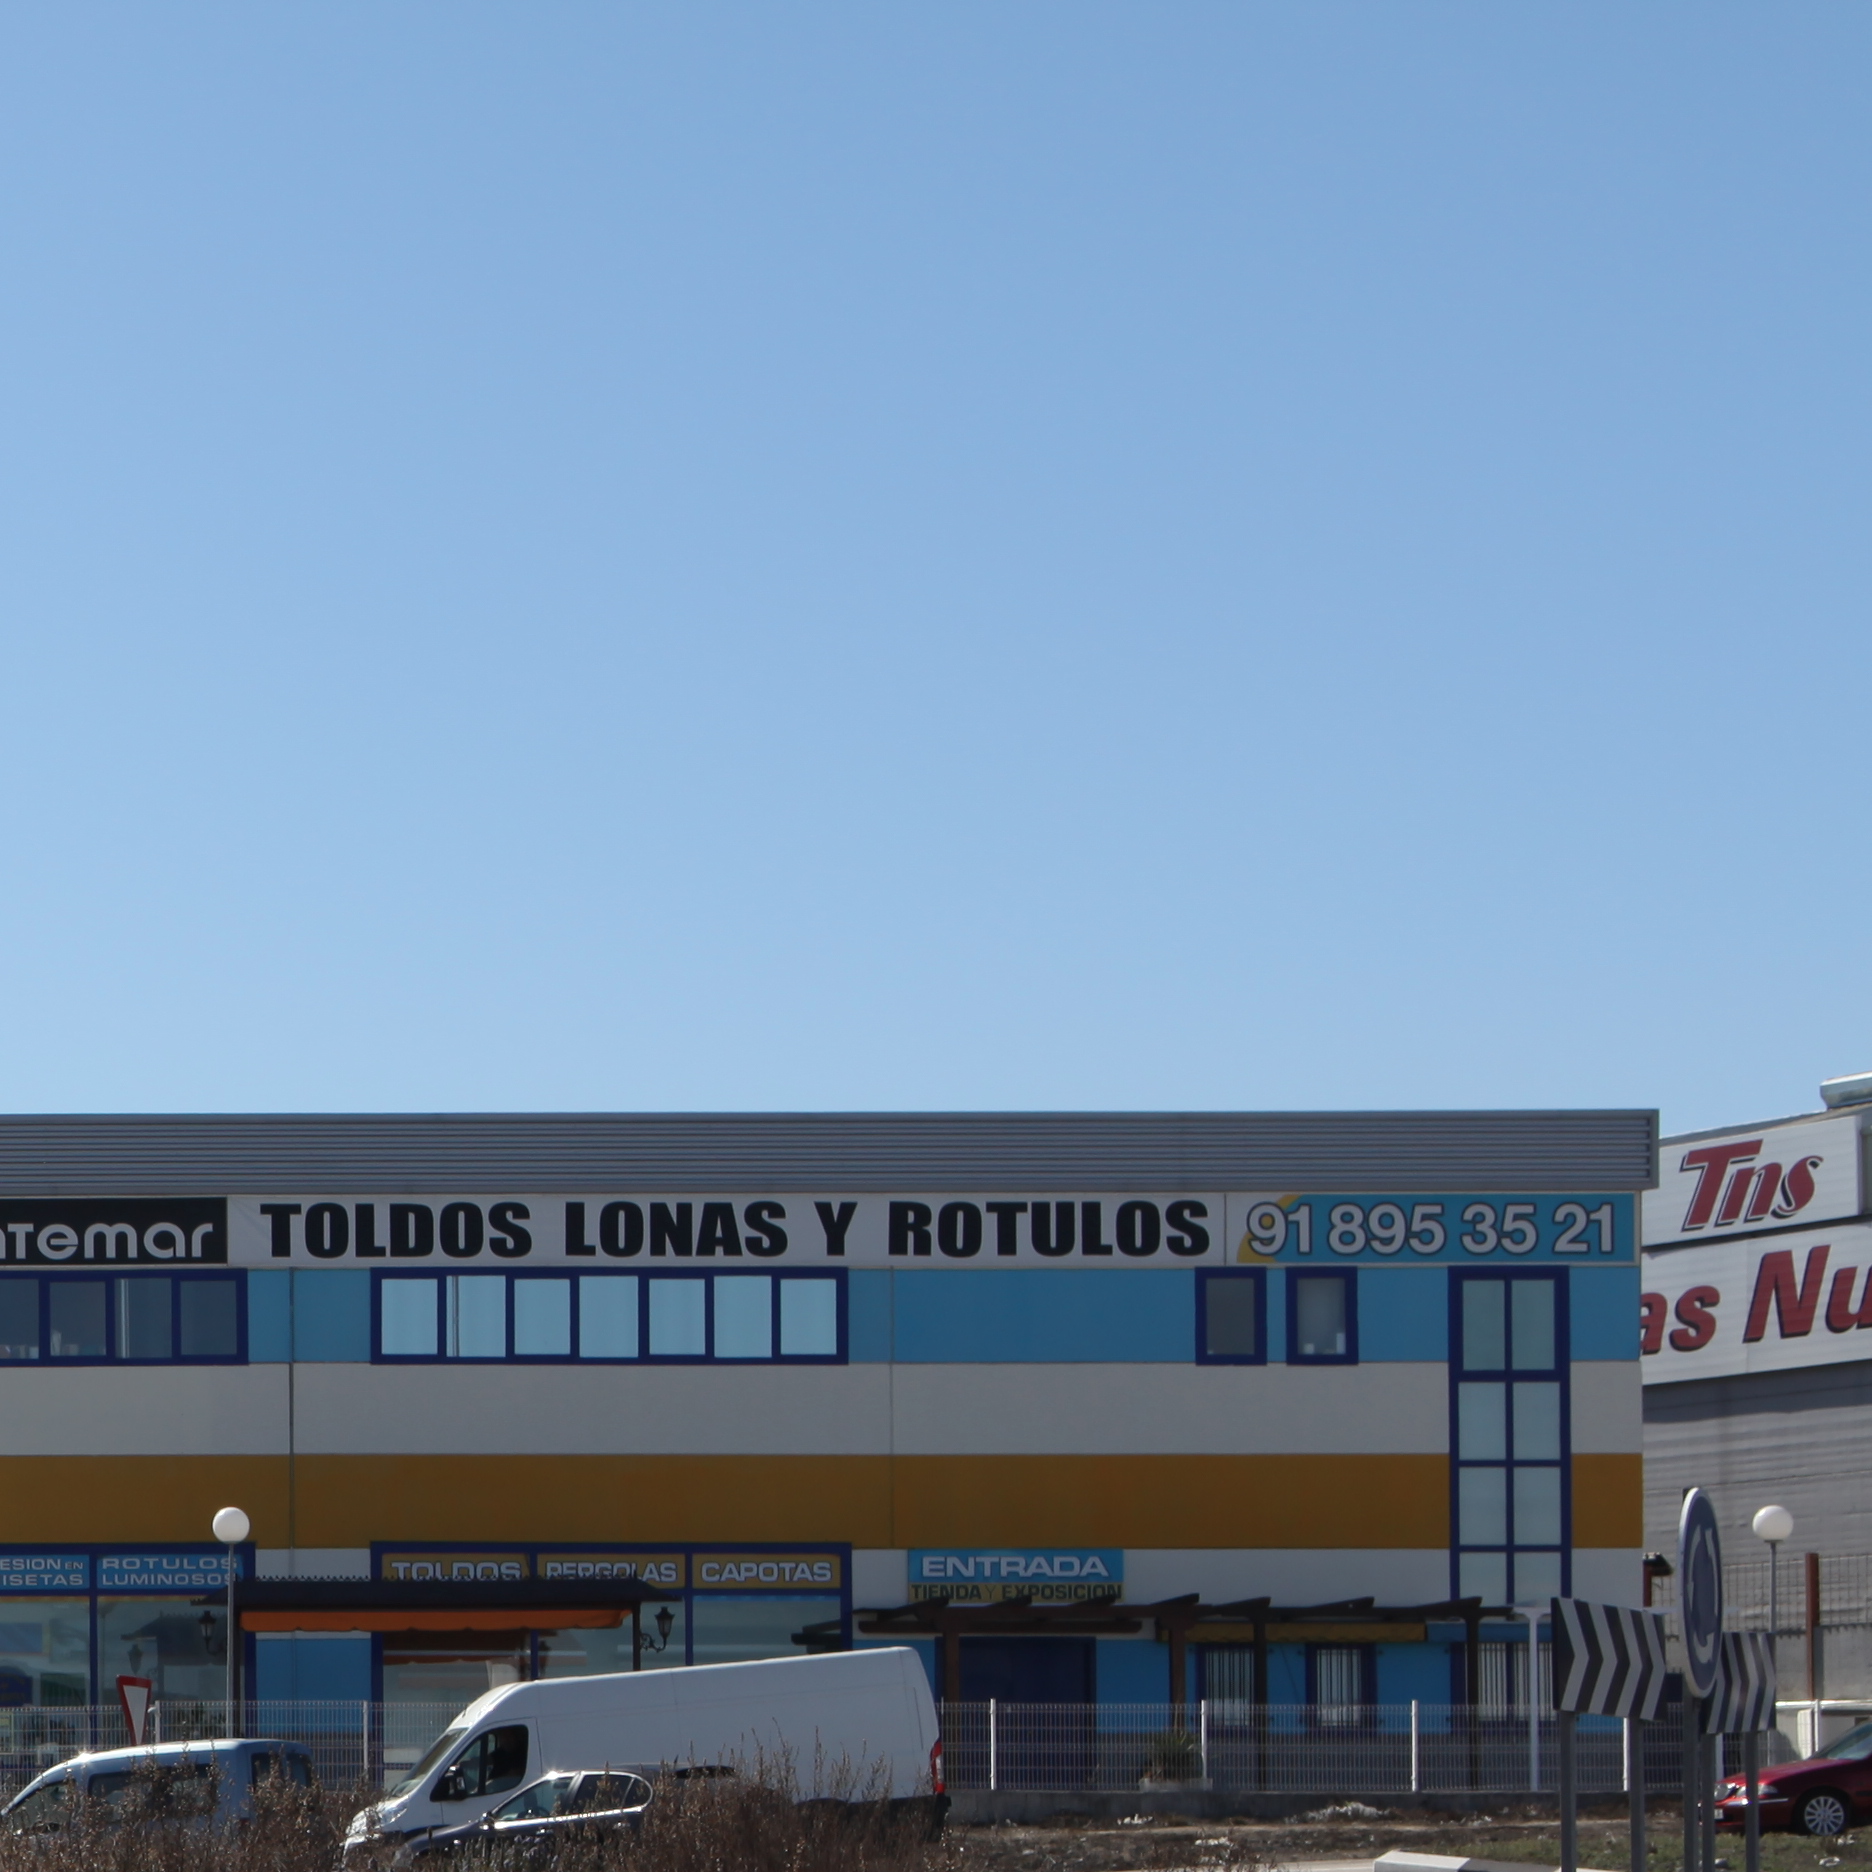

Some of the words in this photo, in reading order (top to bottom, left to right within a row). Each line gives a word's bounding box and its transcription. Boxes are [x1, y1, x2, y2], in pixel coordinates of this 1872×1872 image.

[1679, 1138, 1824, 1233] Tns
[260, 1202, 533, 1259] TOLDOS
[564, 1201, 789, 1258] LONAS
[814, 1201, 858, 1256] Y
[888, 1200, 1210, 1258] ROTULOS
[1246, 1202, 1312, 1256] 91
[1327, 1202, 1447, 1256] 895
[1459, 1202, 1539, 1255] 35
[1552, 1202, 1615, 1254] 21
[64, 1561, 84, 1570] EN
[102, 1557, 238, 1570] ROTULOS
[391, 1562, 521, 1581] TOLDOS
[701, 1562, 832, 1583] CAPOTAS
[922, 1556, 1109, 1577] ENTRADA
[911, 1584, 982, 1600] TIENDA
[985, 1584, 997, 1599] Y
[1002, 1583, 1122, 1600] EXPOSICION
